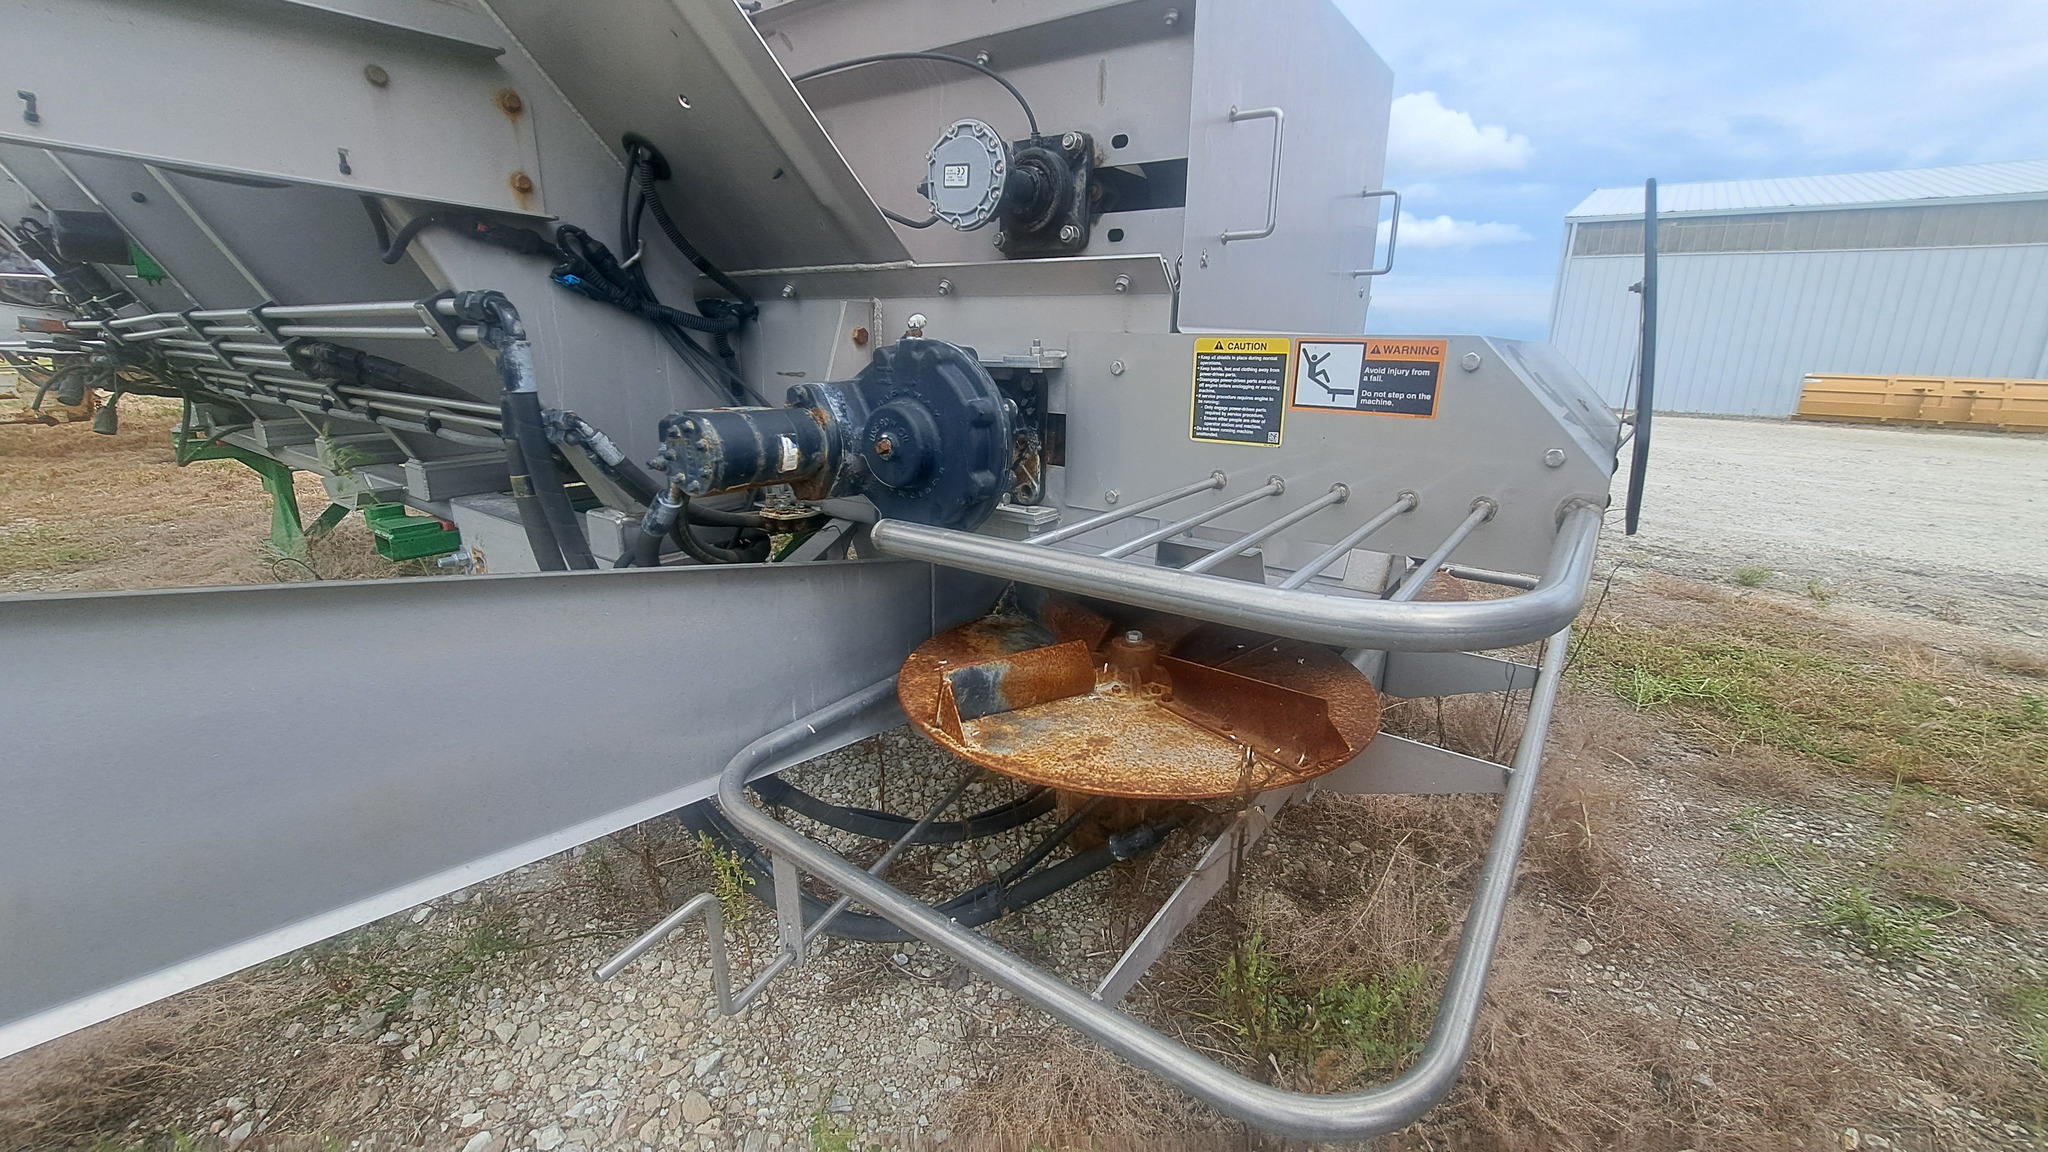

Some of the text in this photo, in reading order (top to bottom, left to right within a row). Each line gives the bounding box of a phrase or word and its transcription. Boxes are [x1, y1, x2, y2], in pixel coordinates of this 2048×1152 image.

[1384, 345, 1439, 355] WARNING
[1387, 367, 1410, 377] injury
[1388, 392, 1405, 401] step
